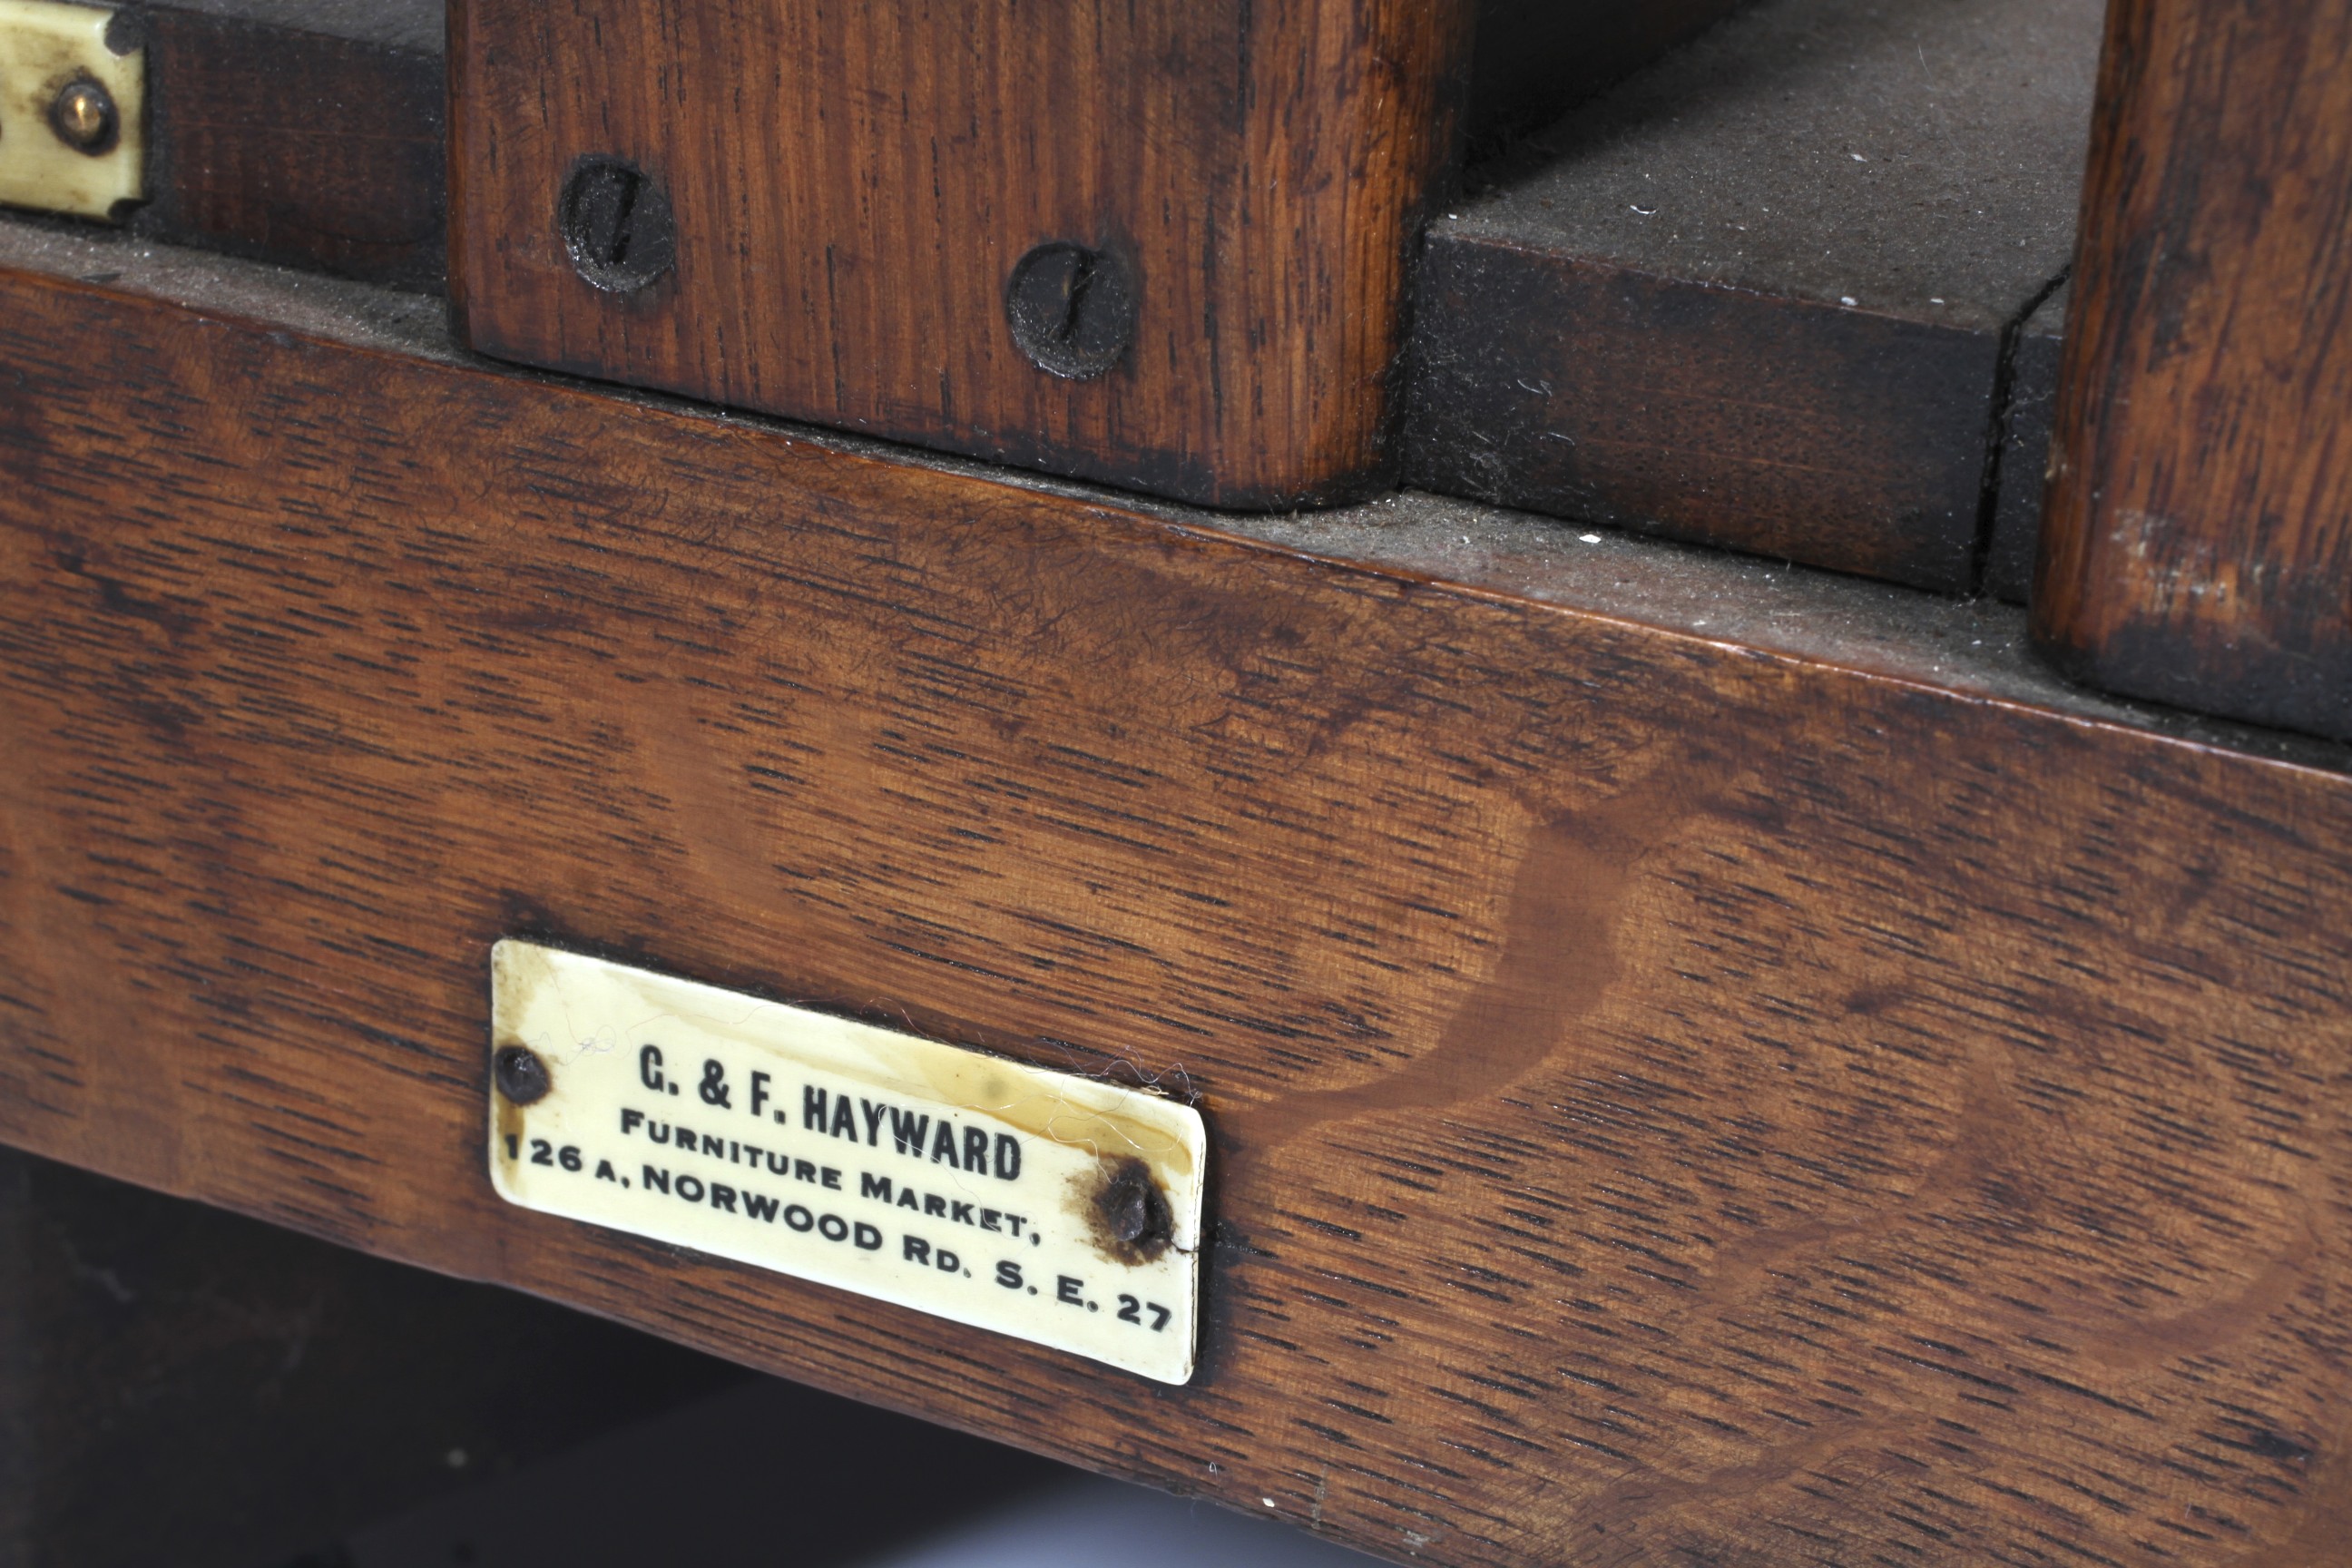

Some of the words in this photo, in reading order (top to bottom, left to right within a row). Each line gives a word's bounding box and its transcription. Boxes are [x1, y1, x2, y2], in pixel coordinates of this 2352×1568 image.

[620, 1107, 843, 1191] FURNITURE
[639, 1044, 680, 1096] G.
[698, 1058, 732, 1110] &
[750, 1070, 786, 1124] F.
[803, 1084, 1023, 1182] HAYWARD
[642, 1164, 884, 1251] NORWOOD
[995, 1259, 1038, 1296] S.
[1056, 1274, 1100, 1313] E.
[1116, 1293, 1173, 1333] 27
